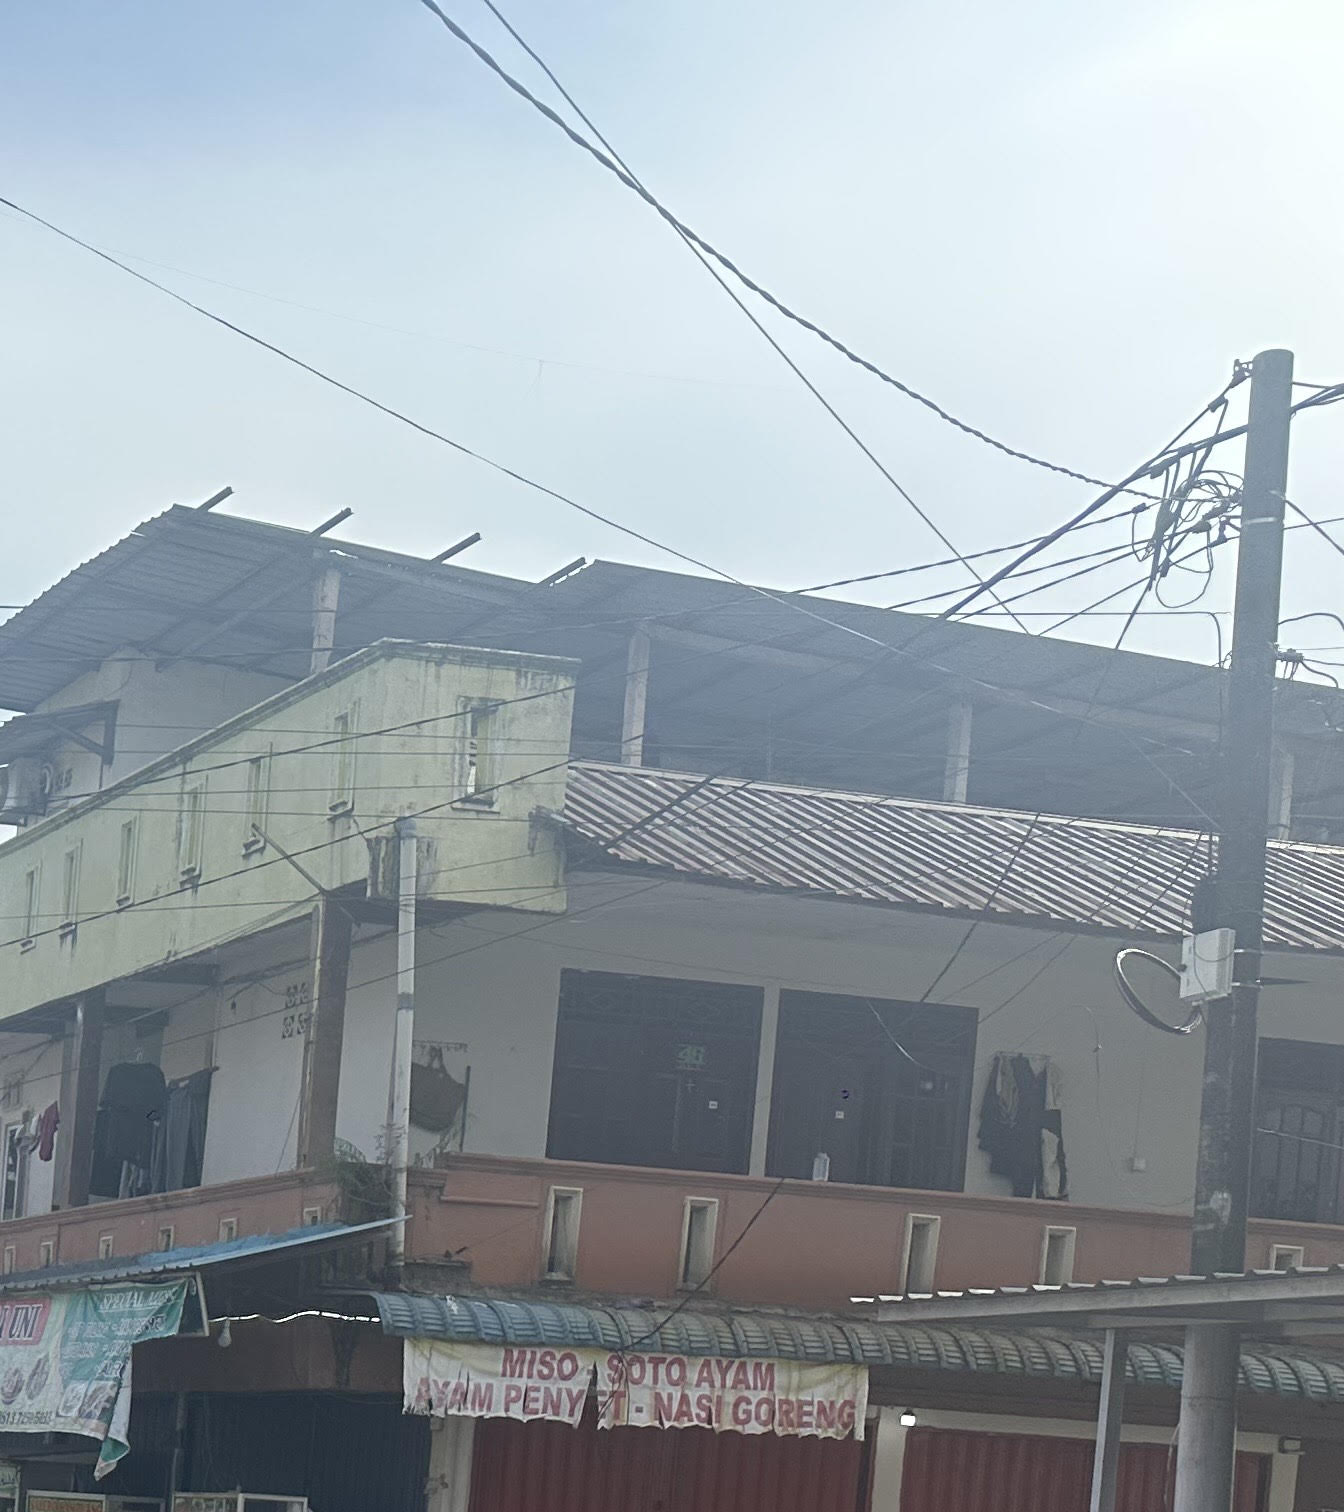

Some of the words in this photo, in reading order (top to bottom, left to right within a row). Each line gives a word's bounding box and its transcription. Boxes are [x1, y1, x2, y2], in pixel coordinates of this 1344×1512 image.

[8, 1303, 43, 1340] UNI
[500, 1349, 580, 1382] MISO
[606, 1353, 688, 1388] SOTO
[694, 1358, 776, 1392] AYAM
[415, 1377, 495, 1414] AYAM
[652, 1390, 721, 1425] NASI
[732, 1393, 857, 1429] GORENG
